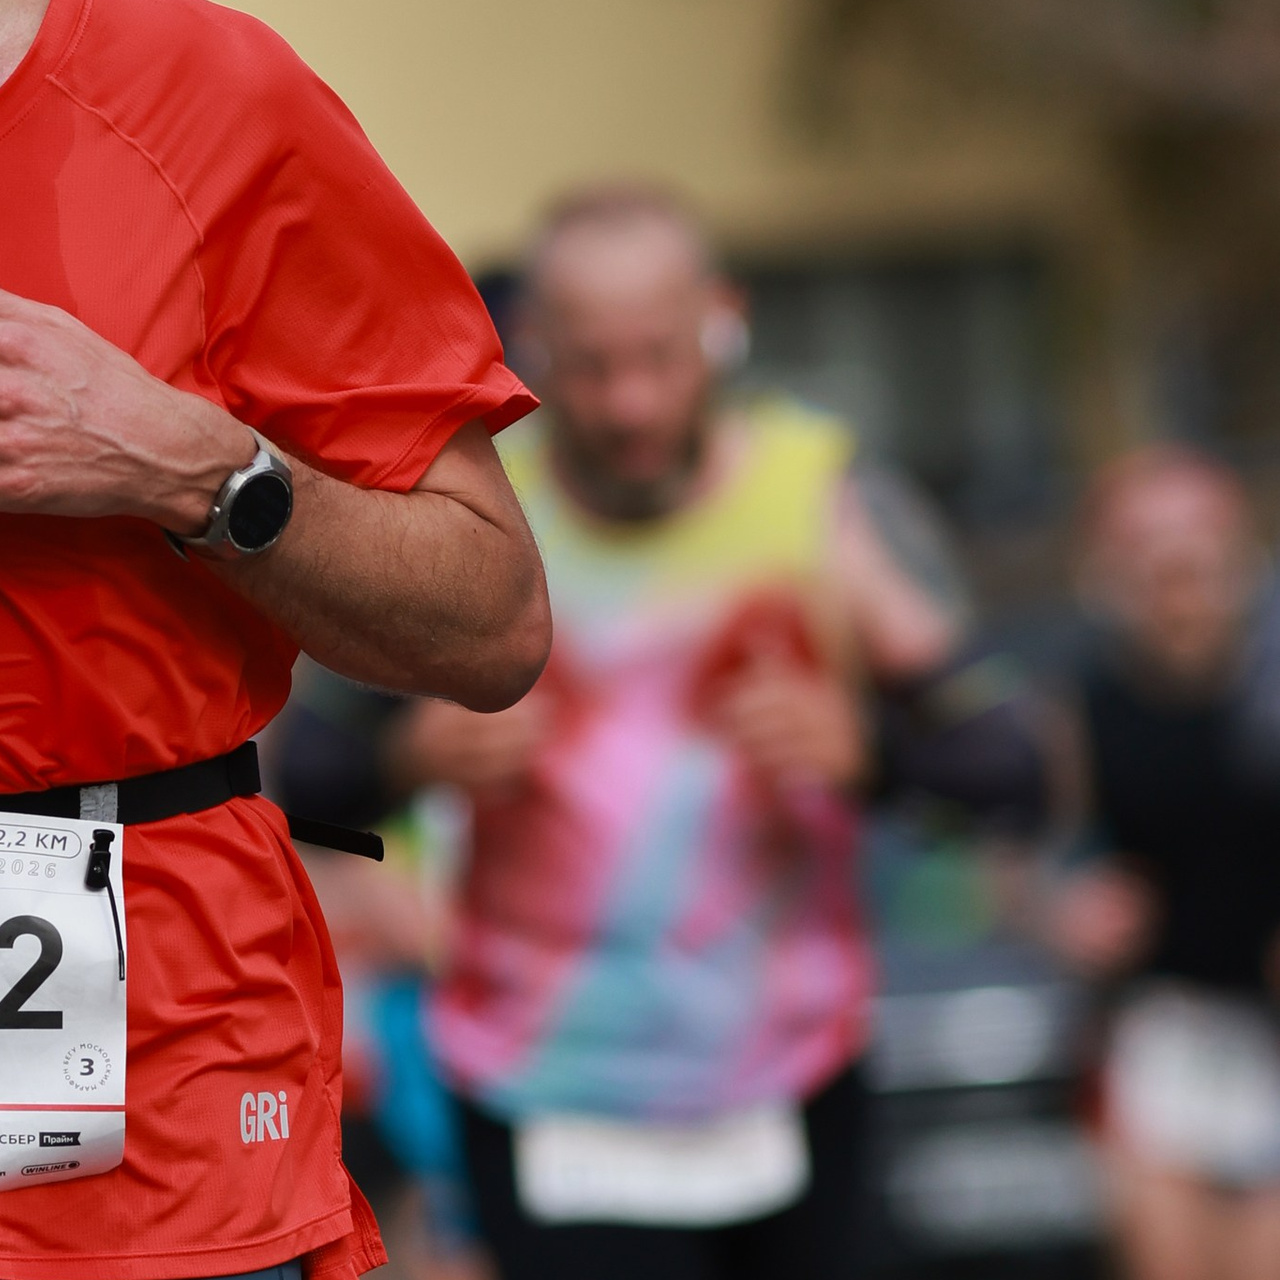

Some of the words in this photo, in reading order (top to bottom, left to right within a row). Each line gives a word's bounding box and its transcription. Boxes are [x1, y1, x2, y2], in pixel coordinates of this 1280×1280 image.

[80, 1058, 94, 1076] 3
[240, 1090, 290, 1144] GRi
[0, 1134, 36, 1145] СБЕР
[43, 1135, 73, 1144] Прайм
[25, 1163, 67, 1174] WINLINE
